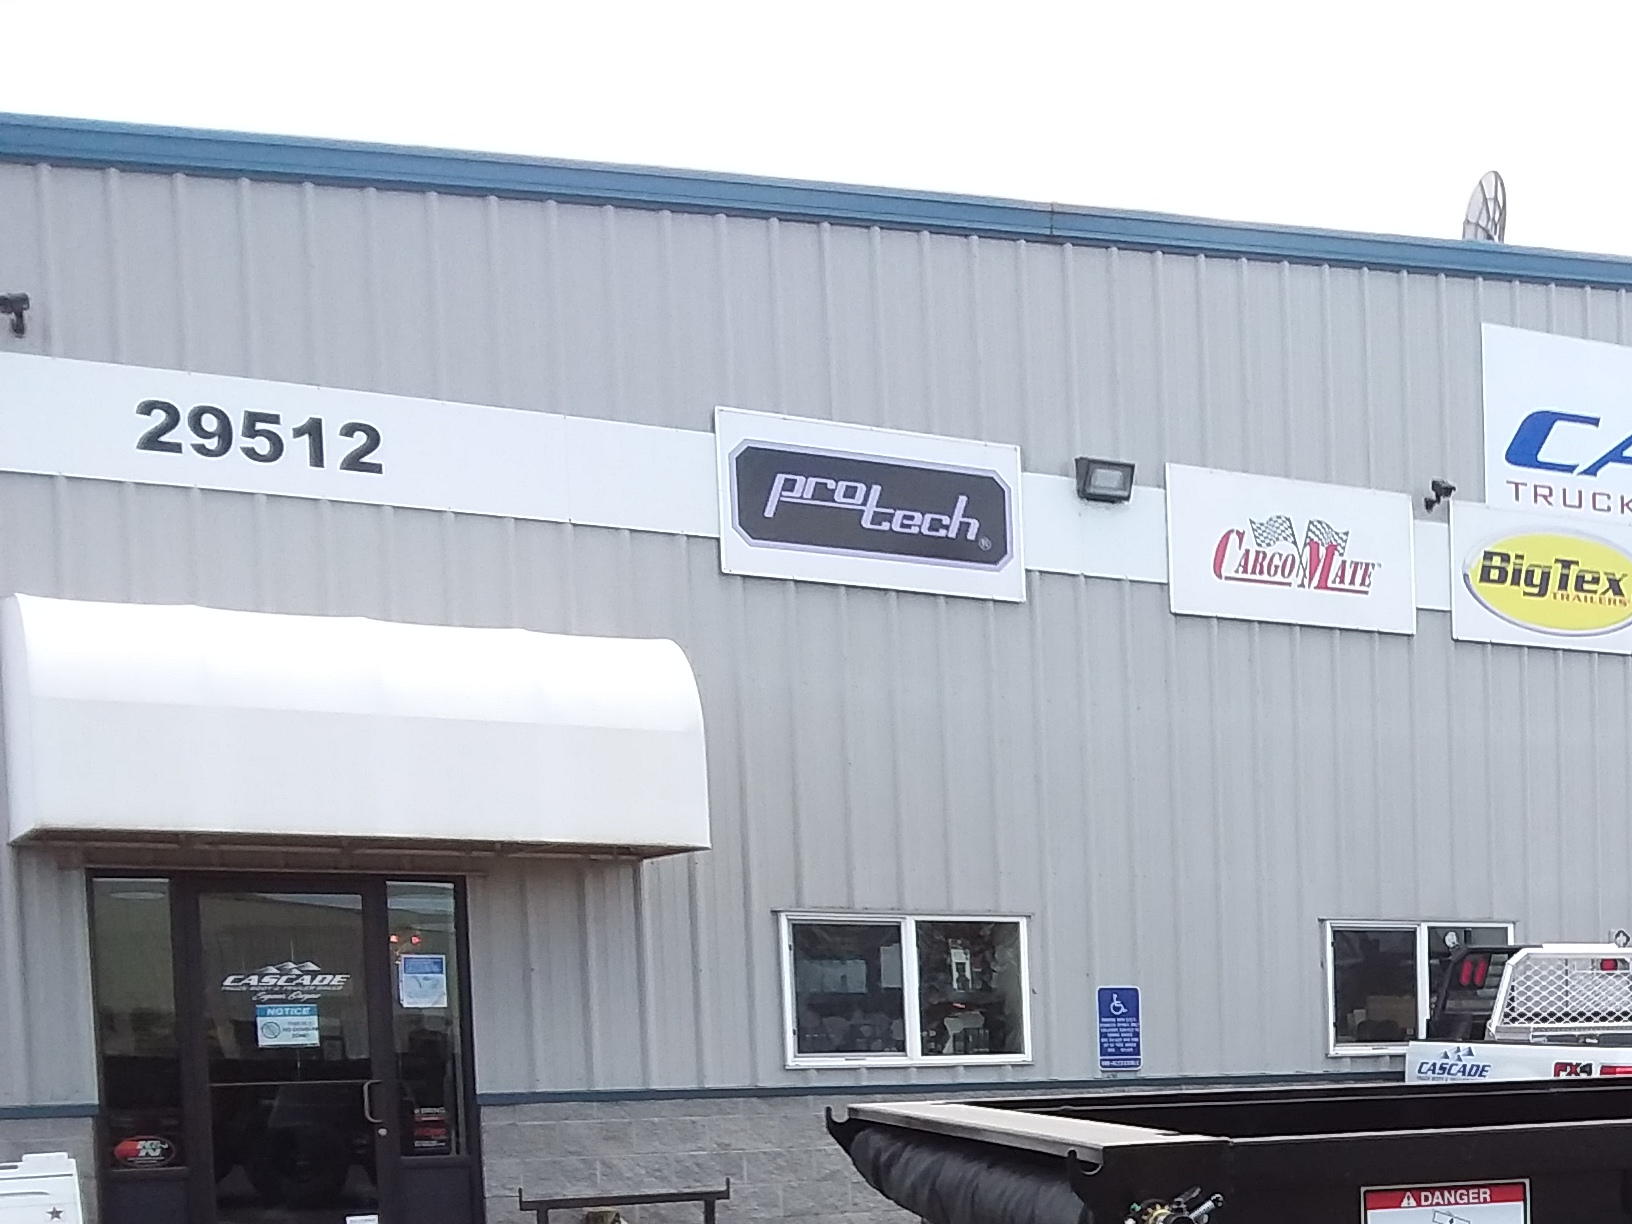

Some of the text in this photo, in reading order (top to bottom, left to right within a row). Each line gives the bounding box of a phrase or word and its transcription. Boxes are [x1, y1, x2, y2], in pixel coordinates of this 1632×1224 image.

[134, 400, 384, 475] 29512
[1478, 549, 1629, 598] BigTex
[1551, 591, 1629, 608] TRAILERS
[222, 974, 351, 986] CASCADE
[266, 1006, 312, 1016] NOTICE
[1417, 1061, 1492, 1079] CASCADE
[1553, 1061, 1594, 1078] FX4
[1420, 1187, 1491, 1206] DANGER
